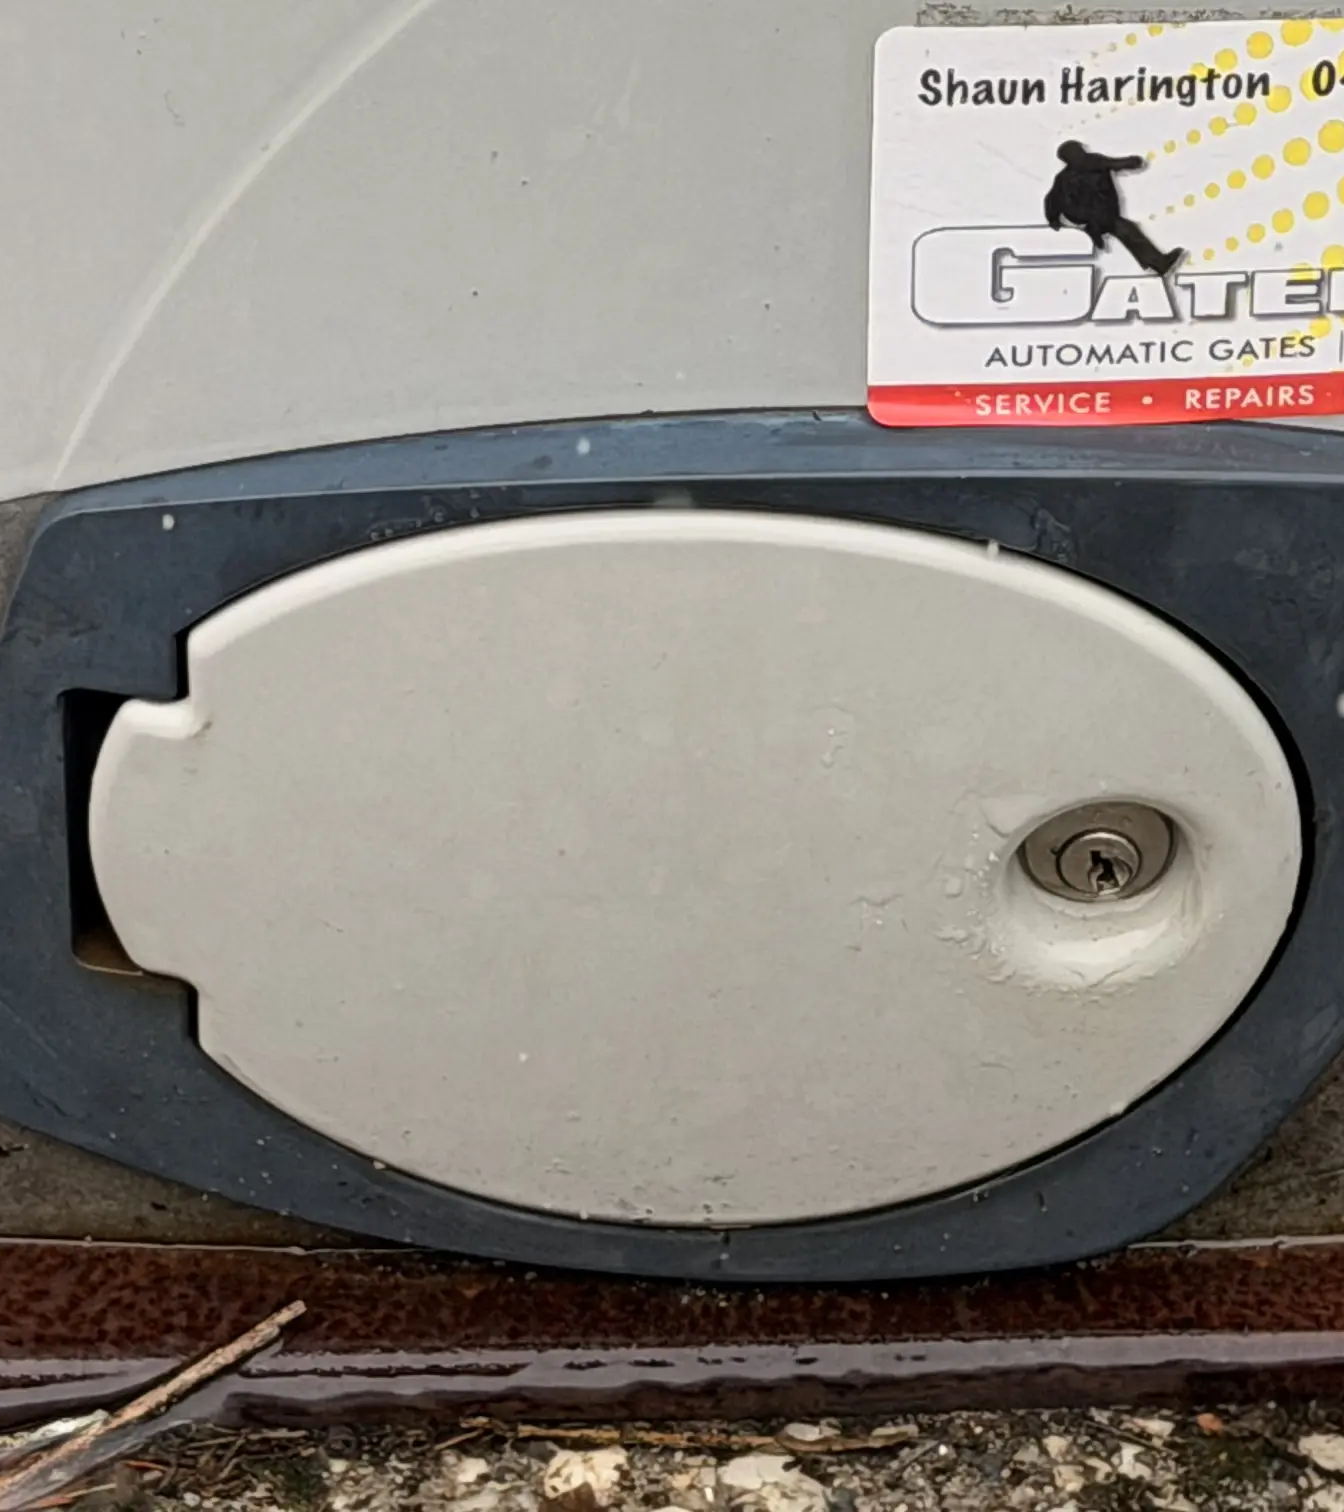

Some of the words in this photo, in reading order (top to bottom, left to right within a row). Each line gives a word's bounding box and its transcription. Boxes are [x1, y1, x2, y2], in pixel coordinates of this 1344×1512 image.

[918, 68, 1047, 106] Shaun
[1060, 66, 1271, 105] Harington
[985, 339, 1195, 368] AUTOMATIC
[1207, 334, 1317, 361] GATES
[975, 390, 1112, 417] SERVICE
[1184, 383, 1315, 410] REPAIRS
